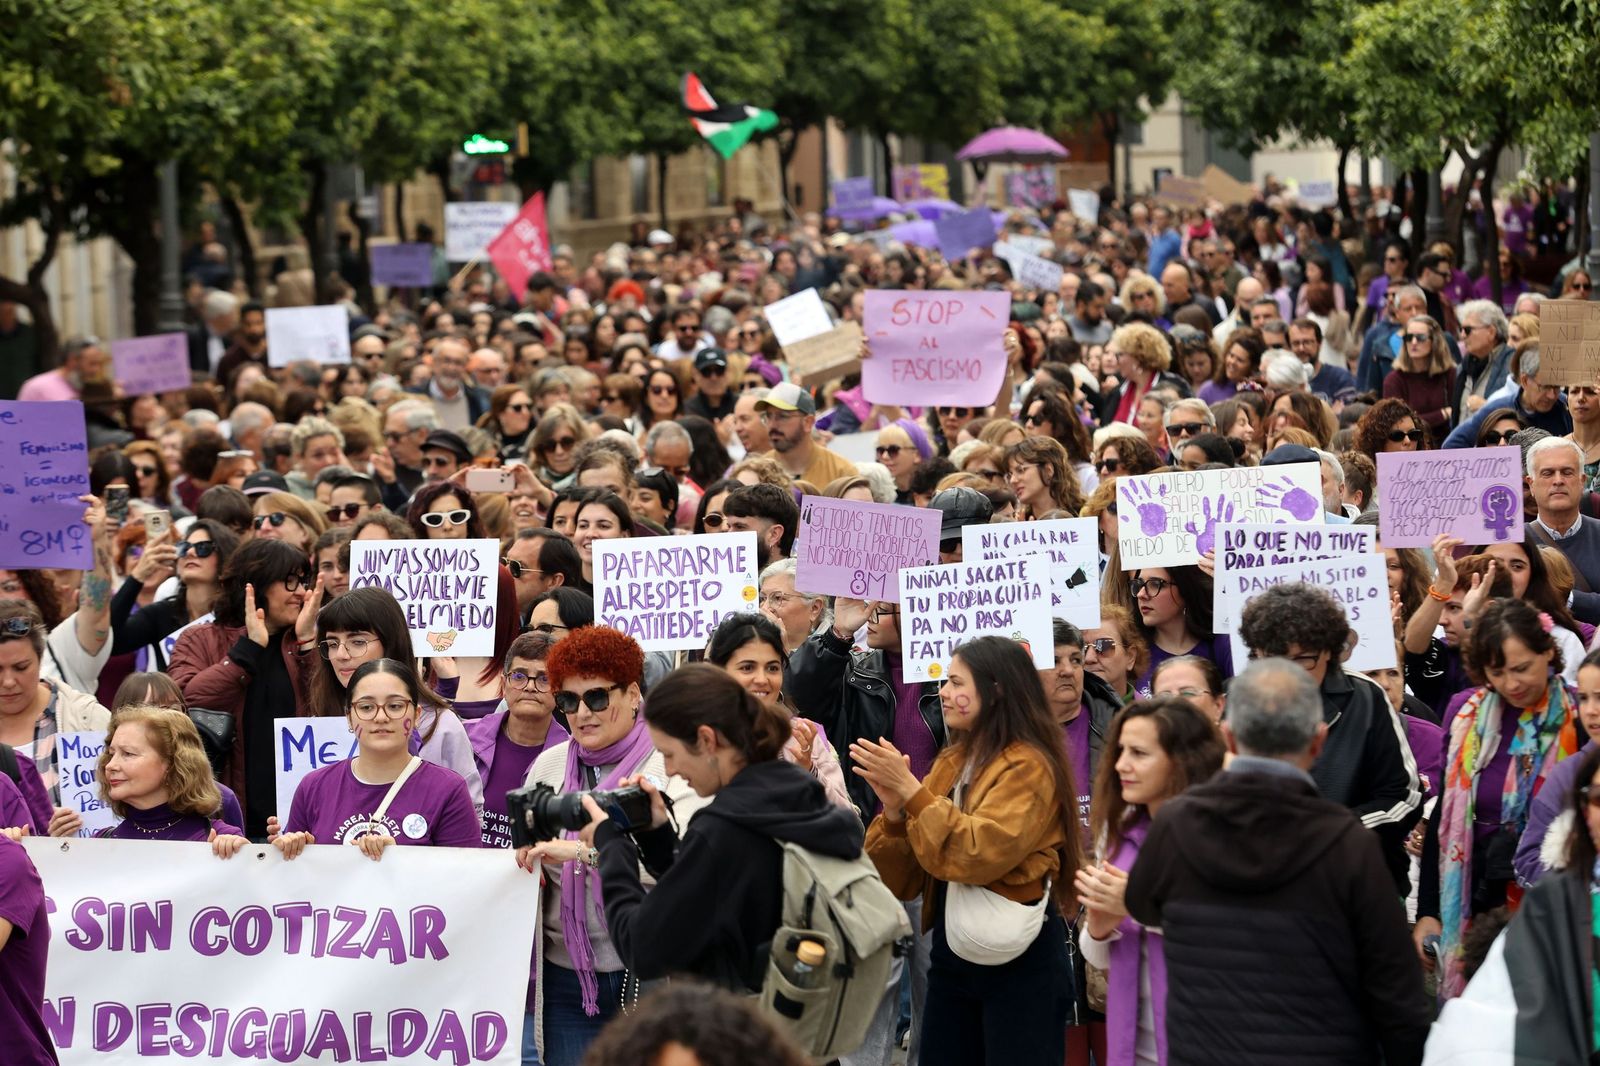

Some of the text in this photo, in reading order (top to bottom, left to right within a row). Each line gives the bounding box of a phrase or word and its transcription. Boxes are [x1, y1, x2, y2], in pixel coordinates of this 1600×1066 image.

[891, 299, 964, 325] STOP
[919, 337, 940, 349] AL
[892, 357, 982, 382] FASCISMO
[1148, 469, 1265, 494] QUIERO PODER
[1161, 491, 1264, 513] SALIR A LA
[830, 507, 863, 532] TODAS
[868, 511, 923, 538] TENEMOS
[856, 532, 867, 552] EL
[871, 533, 929, 558] PROBLEMA
[981, 528, 1079, 549] NI CALLARME
[1121, 535, 1191, 557] MIEDO DE
[1225, 529, 1368, 553] LO QUE NO TUVE
[807, 545, 825, 565] NO
[827, 547, 862, 569] SOMOS
[1225, 552, 1265, 570] PARA
[850, 570, 887, 598] 8M
[1301, 570, 1320, 585] MI
[1326, 566, 1366, 585] SITIO
[407, 602, 494, 631] EL MIEDO
[906, 596, 930, 613] TU
[911, 614, 932, 636] PA
[940, 613, 967, 633] NO
[333, 813, 365, 840] MAREA
[481, 834, 492, 844] EL
[65, 896, 452, 966] SIN COTIZAR
[93, 1000, 509, 1066] DESIGUALDAD
